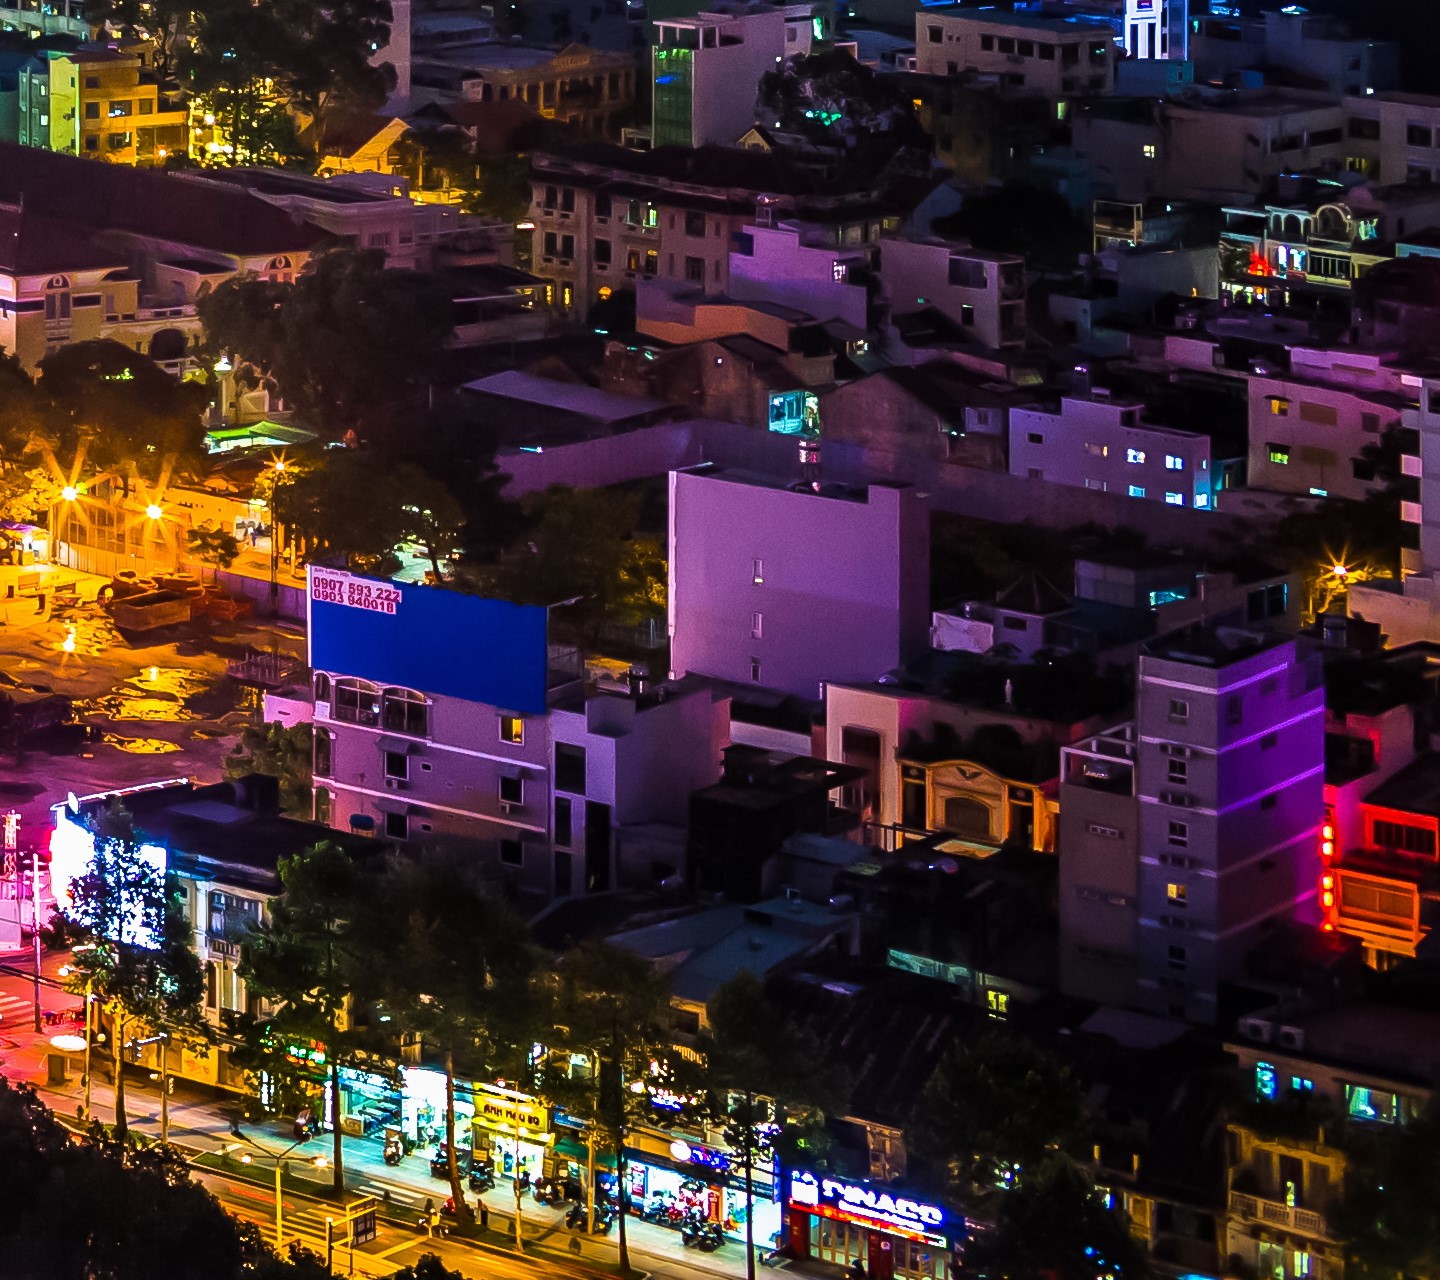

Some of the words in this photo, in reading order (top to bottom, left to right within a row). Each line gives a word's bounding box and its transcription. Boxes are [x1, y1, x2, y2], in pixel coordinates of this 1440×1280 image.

[312, 576, 344, 593] 0907
[348, 582, 372, 598] 593
[375, 587, 400, 602] 222
[312, 588, 344, 604] 0903
